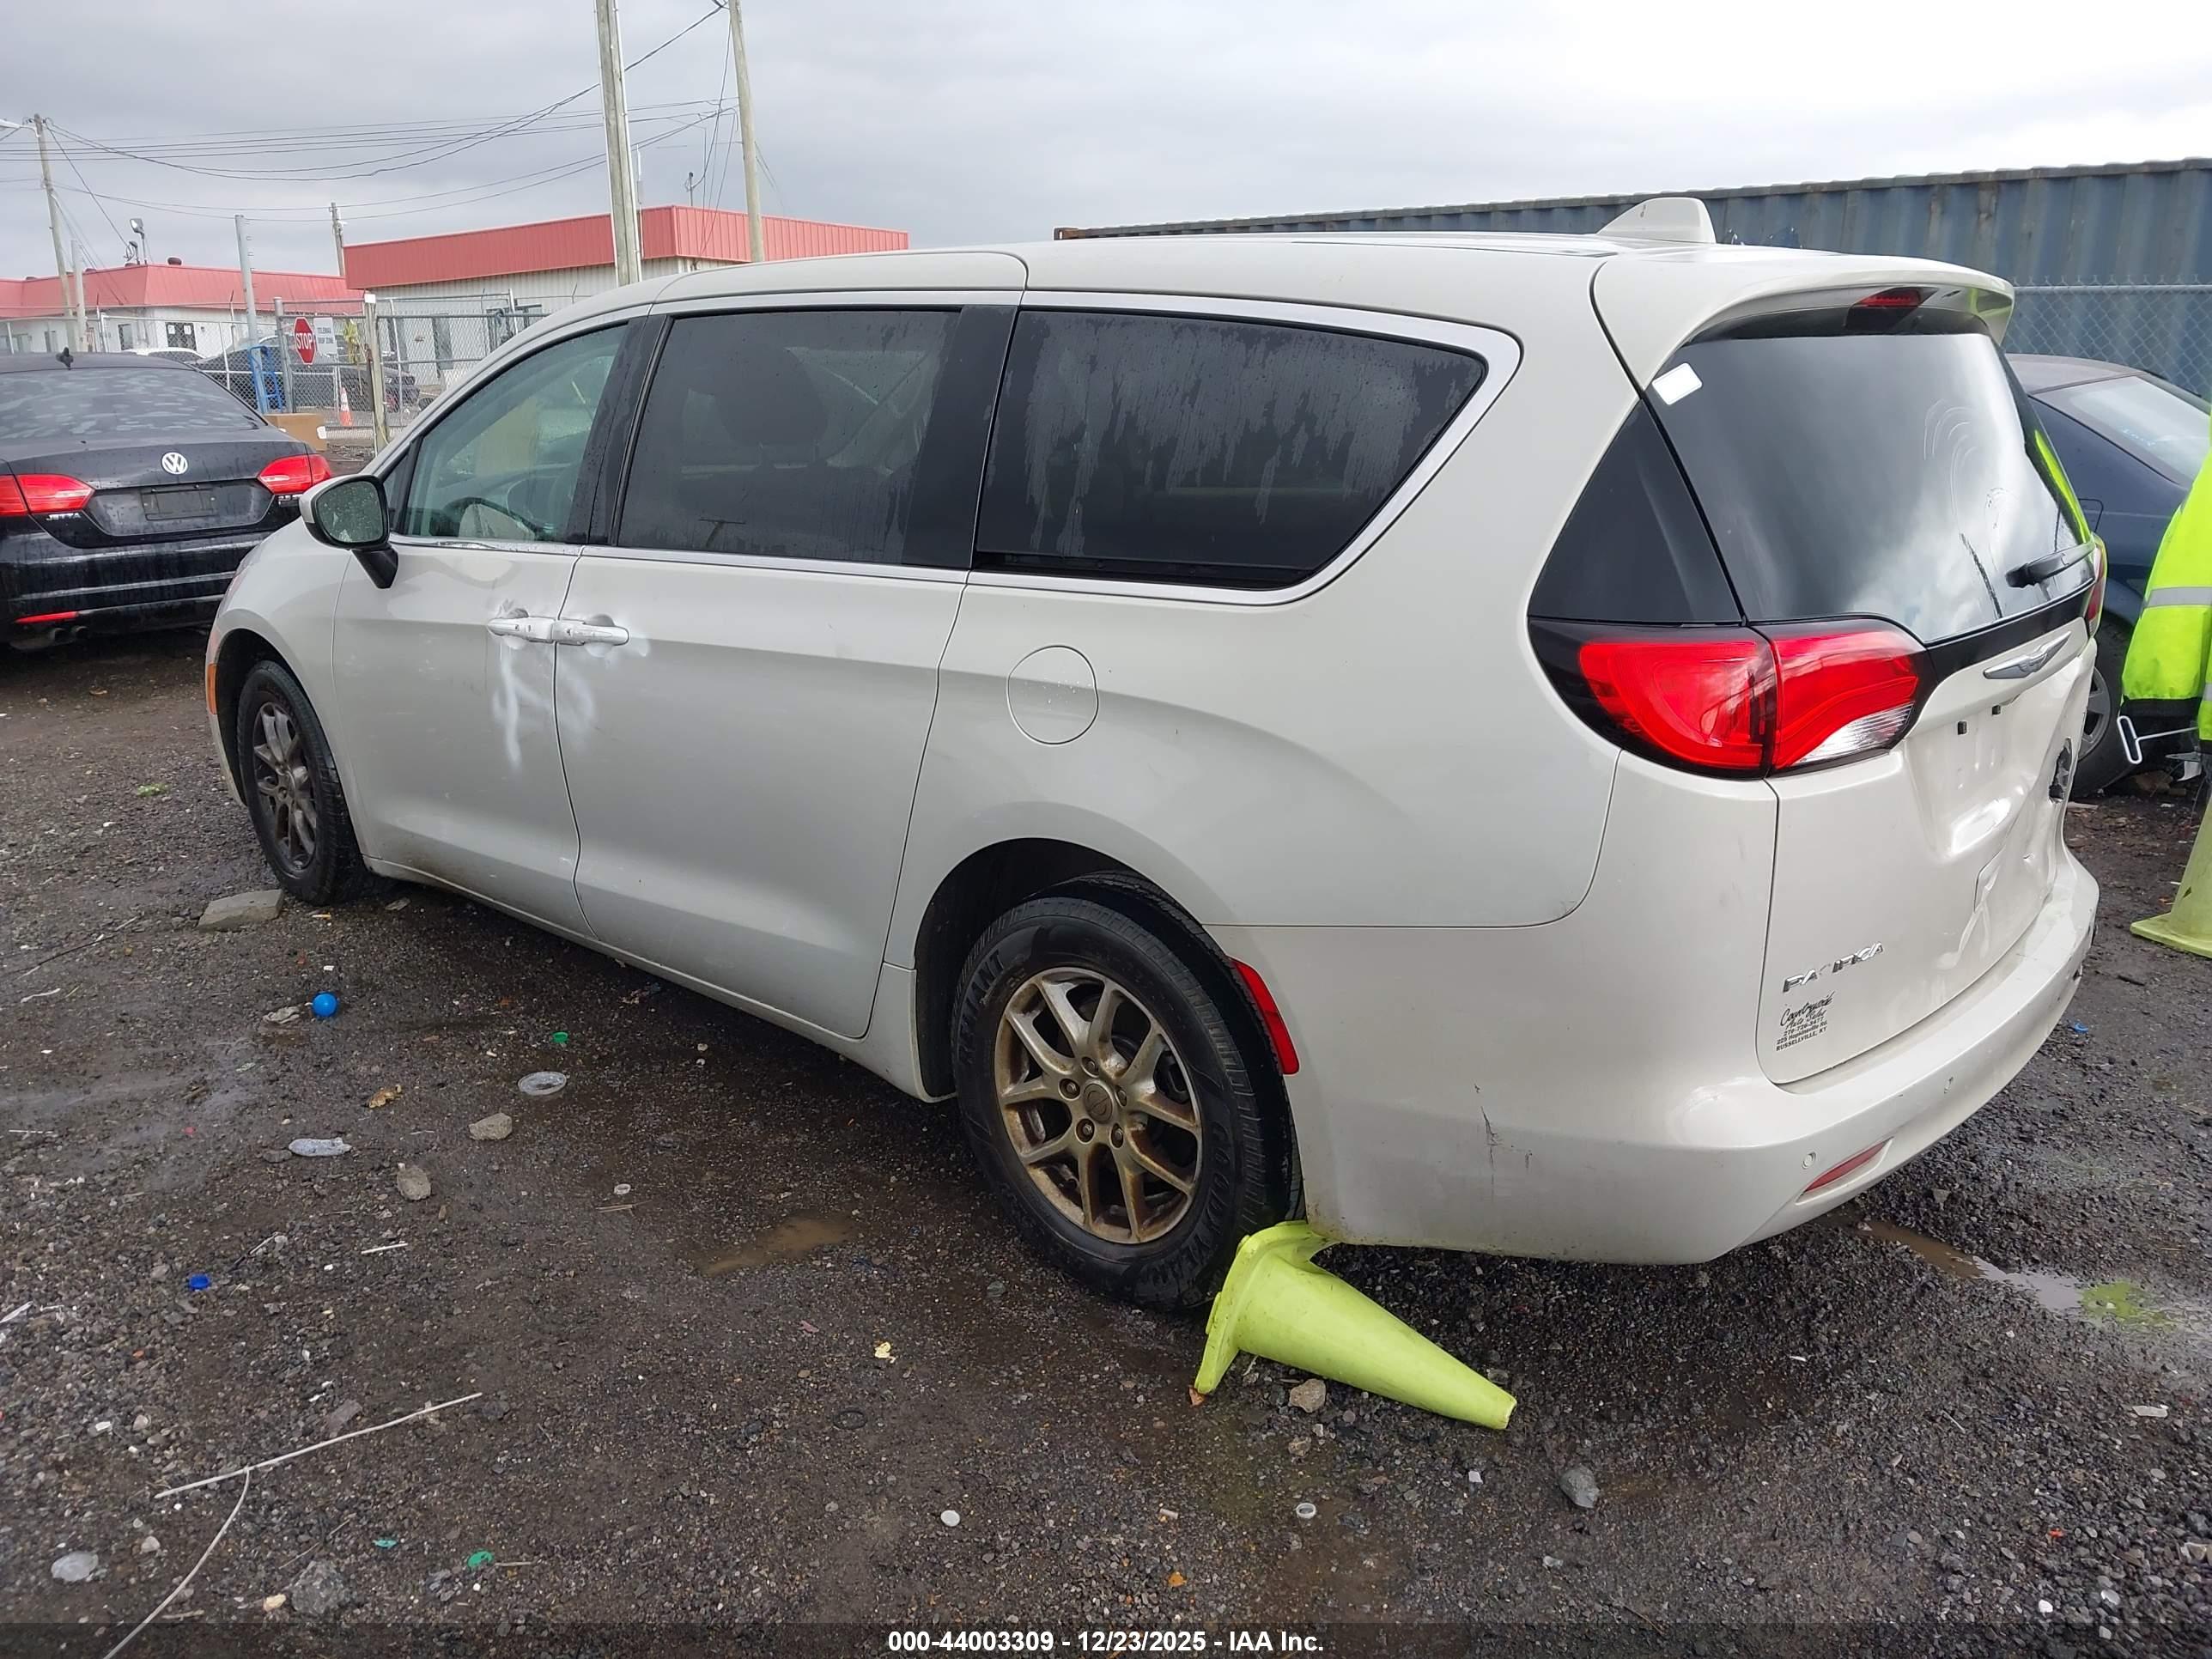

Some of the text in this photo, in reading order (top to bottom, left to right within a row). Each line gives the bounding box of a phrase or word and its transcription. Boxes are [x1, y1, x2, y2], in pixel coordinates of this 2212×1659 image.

[295, 332, 313, 350] STOP
[46, 513, 82, 521] JETTA
[1776, 1030, 1818, 1052] RUSSELLVILLE,
